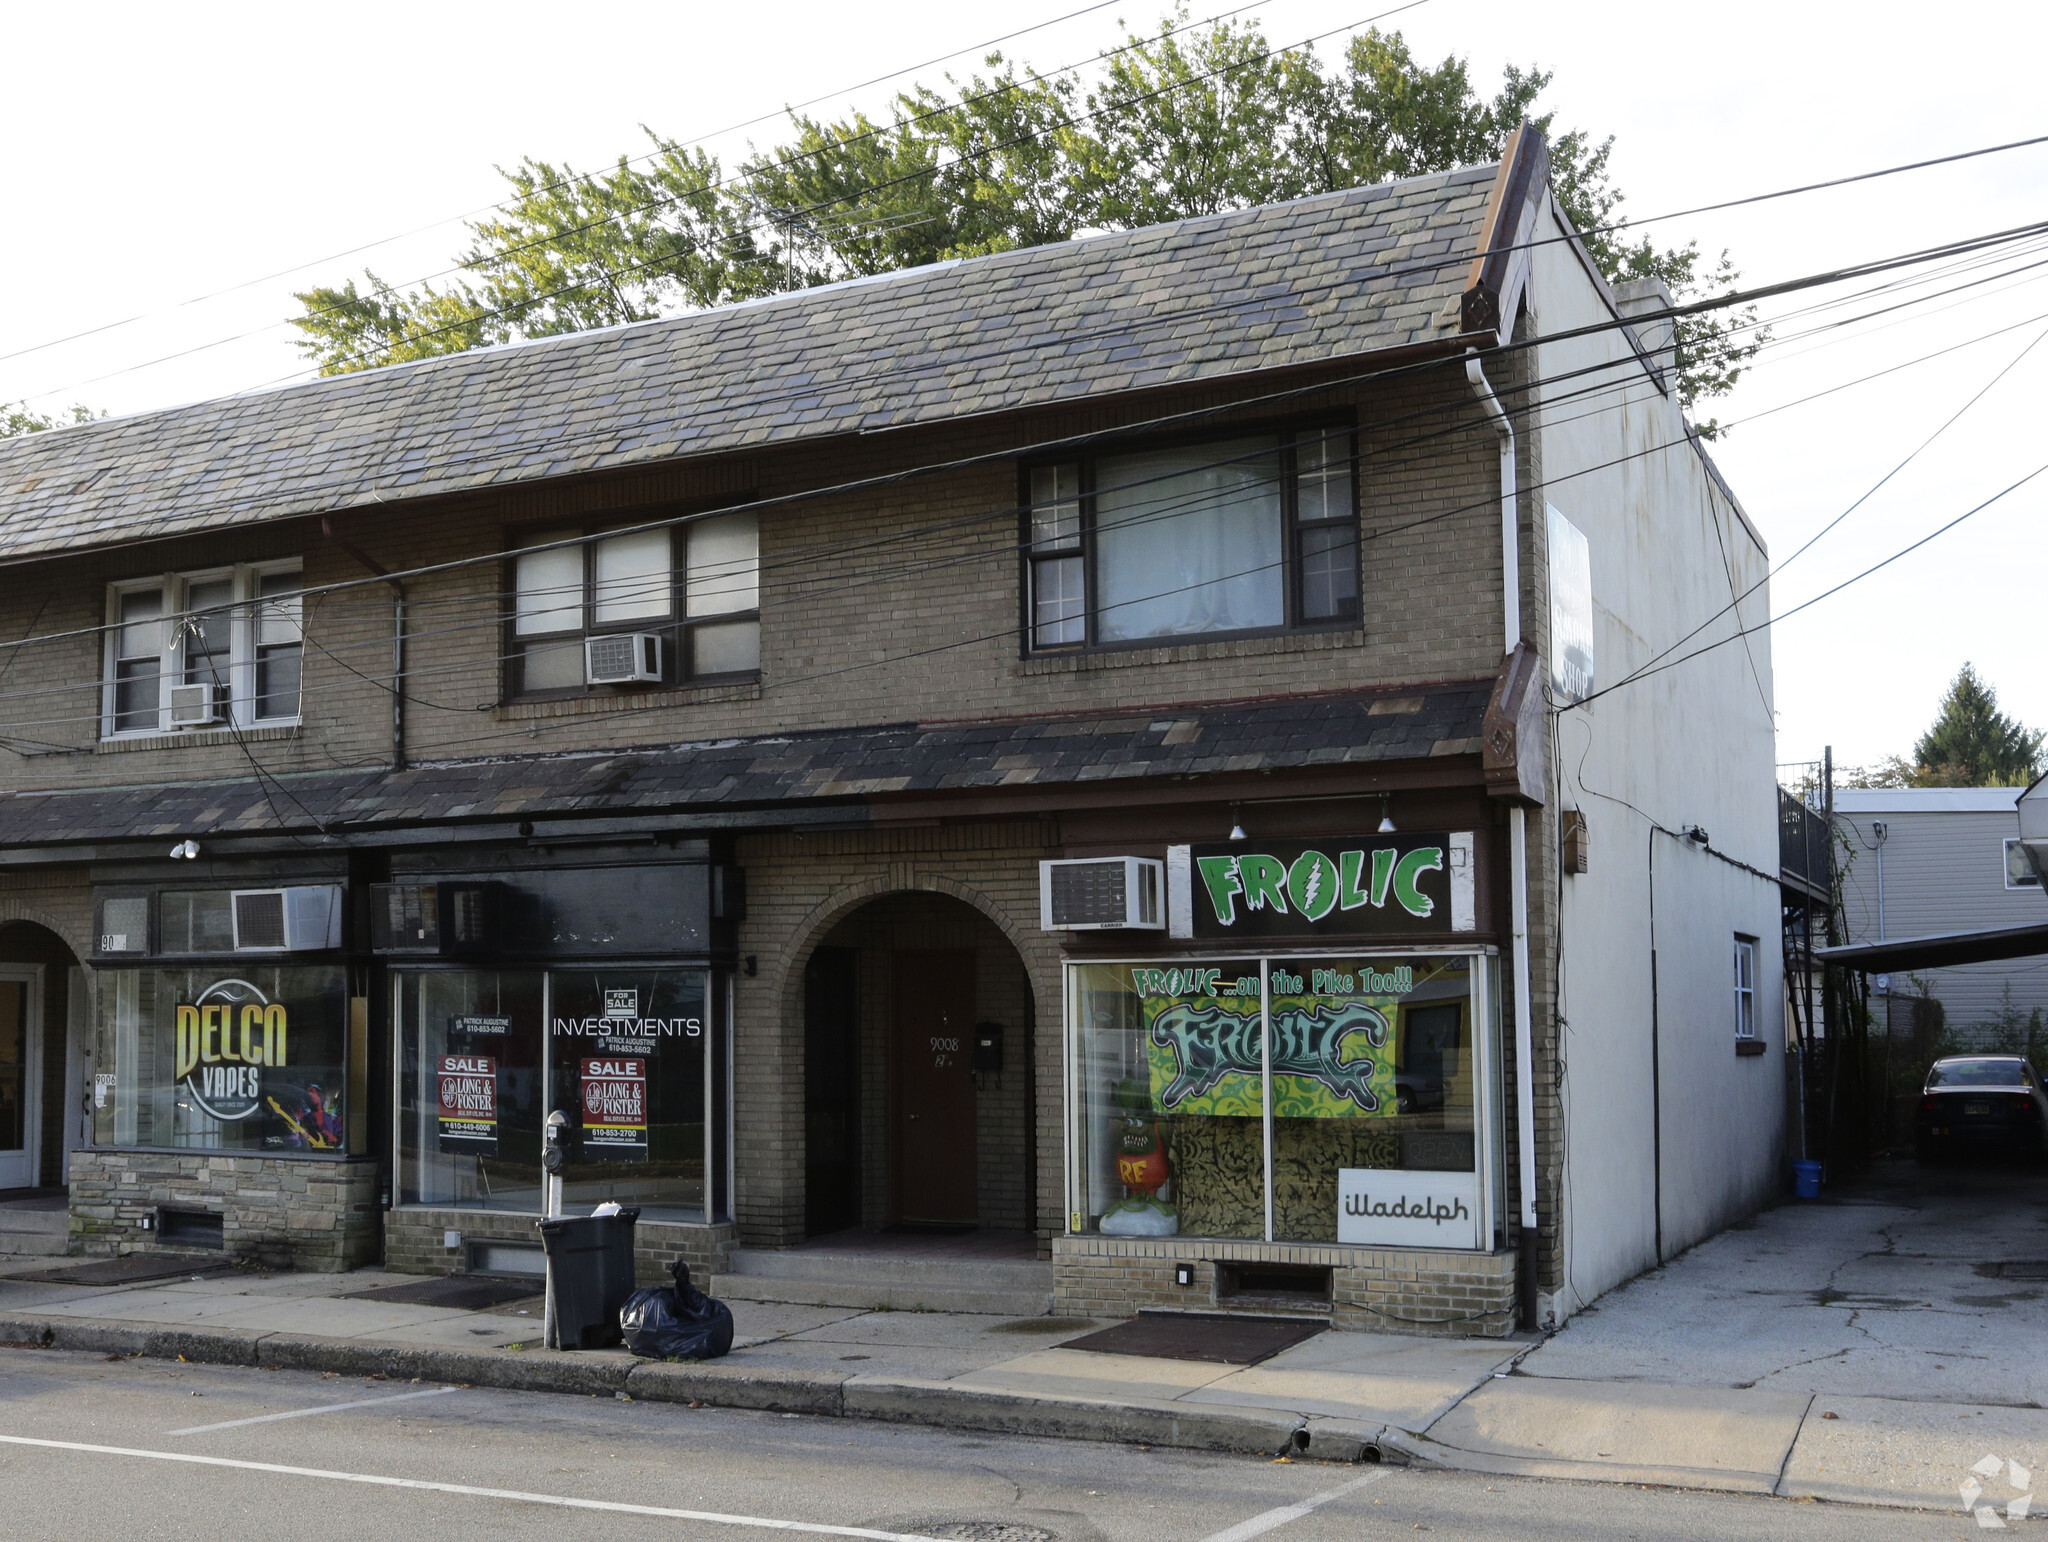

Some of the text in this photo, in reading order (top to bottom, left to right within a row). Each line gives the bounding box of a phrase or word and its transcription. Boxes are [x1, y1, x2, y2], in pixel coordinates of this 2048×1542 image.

[1561, 656, 1588, 699] SHOP
[1197, 847, 1443, 926] FROLIC
[1132, 967, 1221, 999] FROLIC
[1271, 969, 1304, 995] the
[1312, 967, 1354, 994] Pike
[1358, 965, 1413, 993] Too!!!
[607, 999, 635, 1008] SALE
[463, 1017, 483, 1025] PATRICK
[483, 1018, 509, 1026] AUGUSTINE
[466, 1025, 506, 1033] 610-853-5602
[553, 1018, 700, 1037] INVESTMENTS
[176, 1004, 287, 1080] DELCO
[605, 1036, 625, 1044] PATRICK
[625, 1038, 656, 1046] AUGUSTINE
[609, 1044, 651, 1054] 610-853-5602
[930, 1036, 960, 1052] 9008
[444, 1057, 489, 1073] SALE
[588, 1061, 638, 1076] SALE
[95, 1074, 116, 1085] 9006
[203, 1066, 259, 1098] VAPES
[456, 1078, 493, 1095] LONG &
[602, 1082, 642, 1099] LONG &
[457, 1094, 492, 1111] FOSTER
[603, 1099, 642, 1115] FOSTER
[450, 1122, 491, 1131] 610-449-6006
[592, 1128, 637, 1137] 610-853-2700
[1408, 1141, 1465, 1162] OPEN
[1344, 1193, 1469, 1226] illadelph
